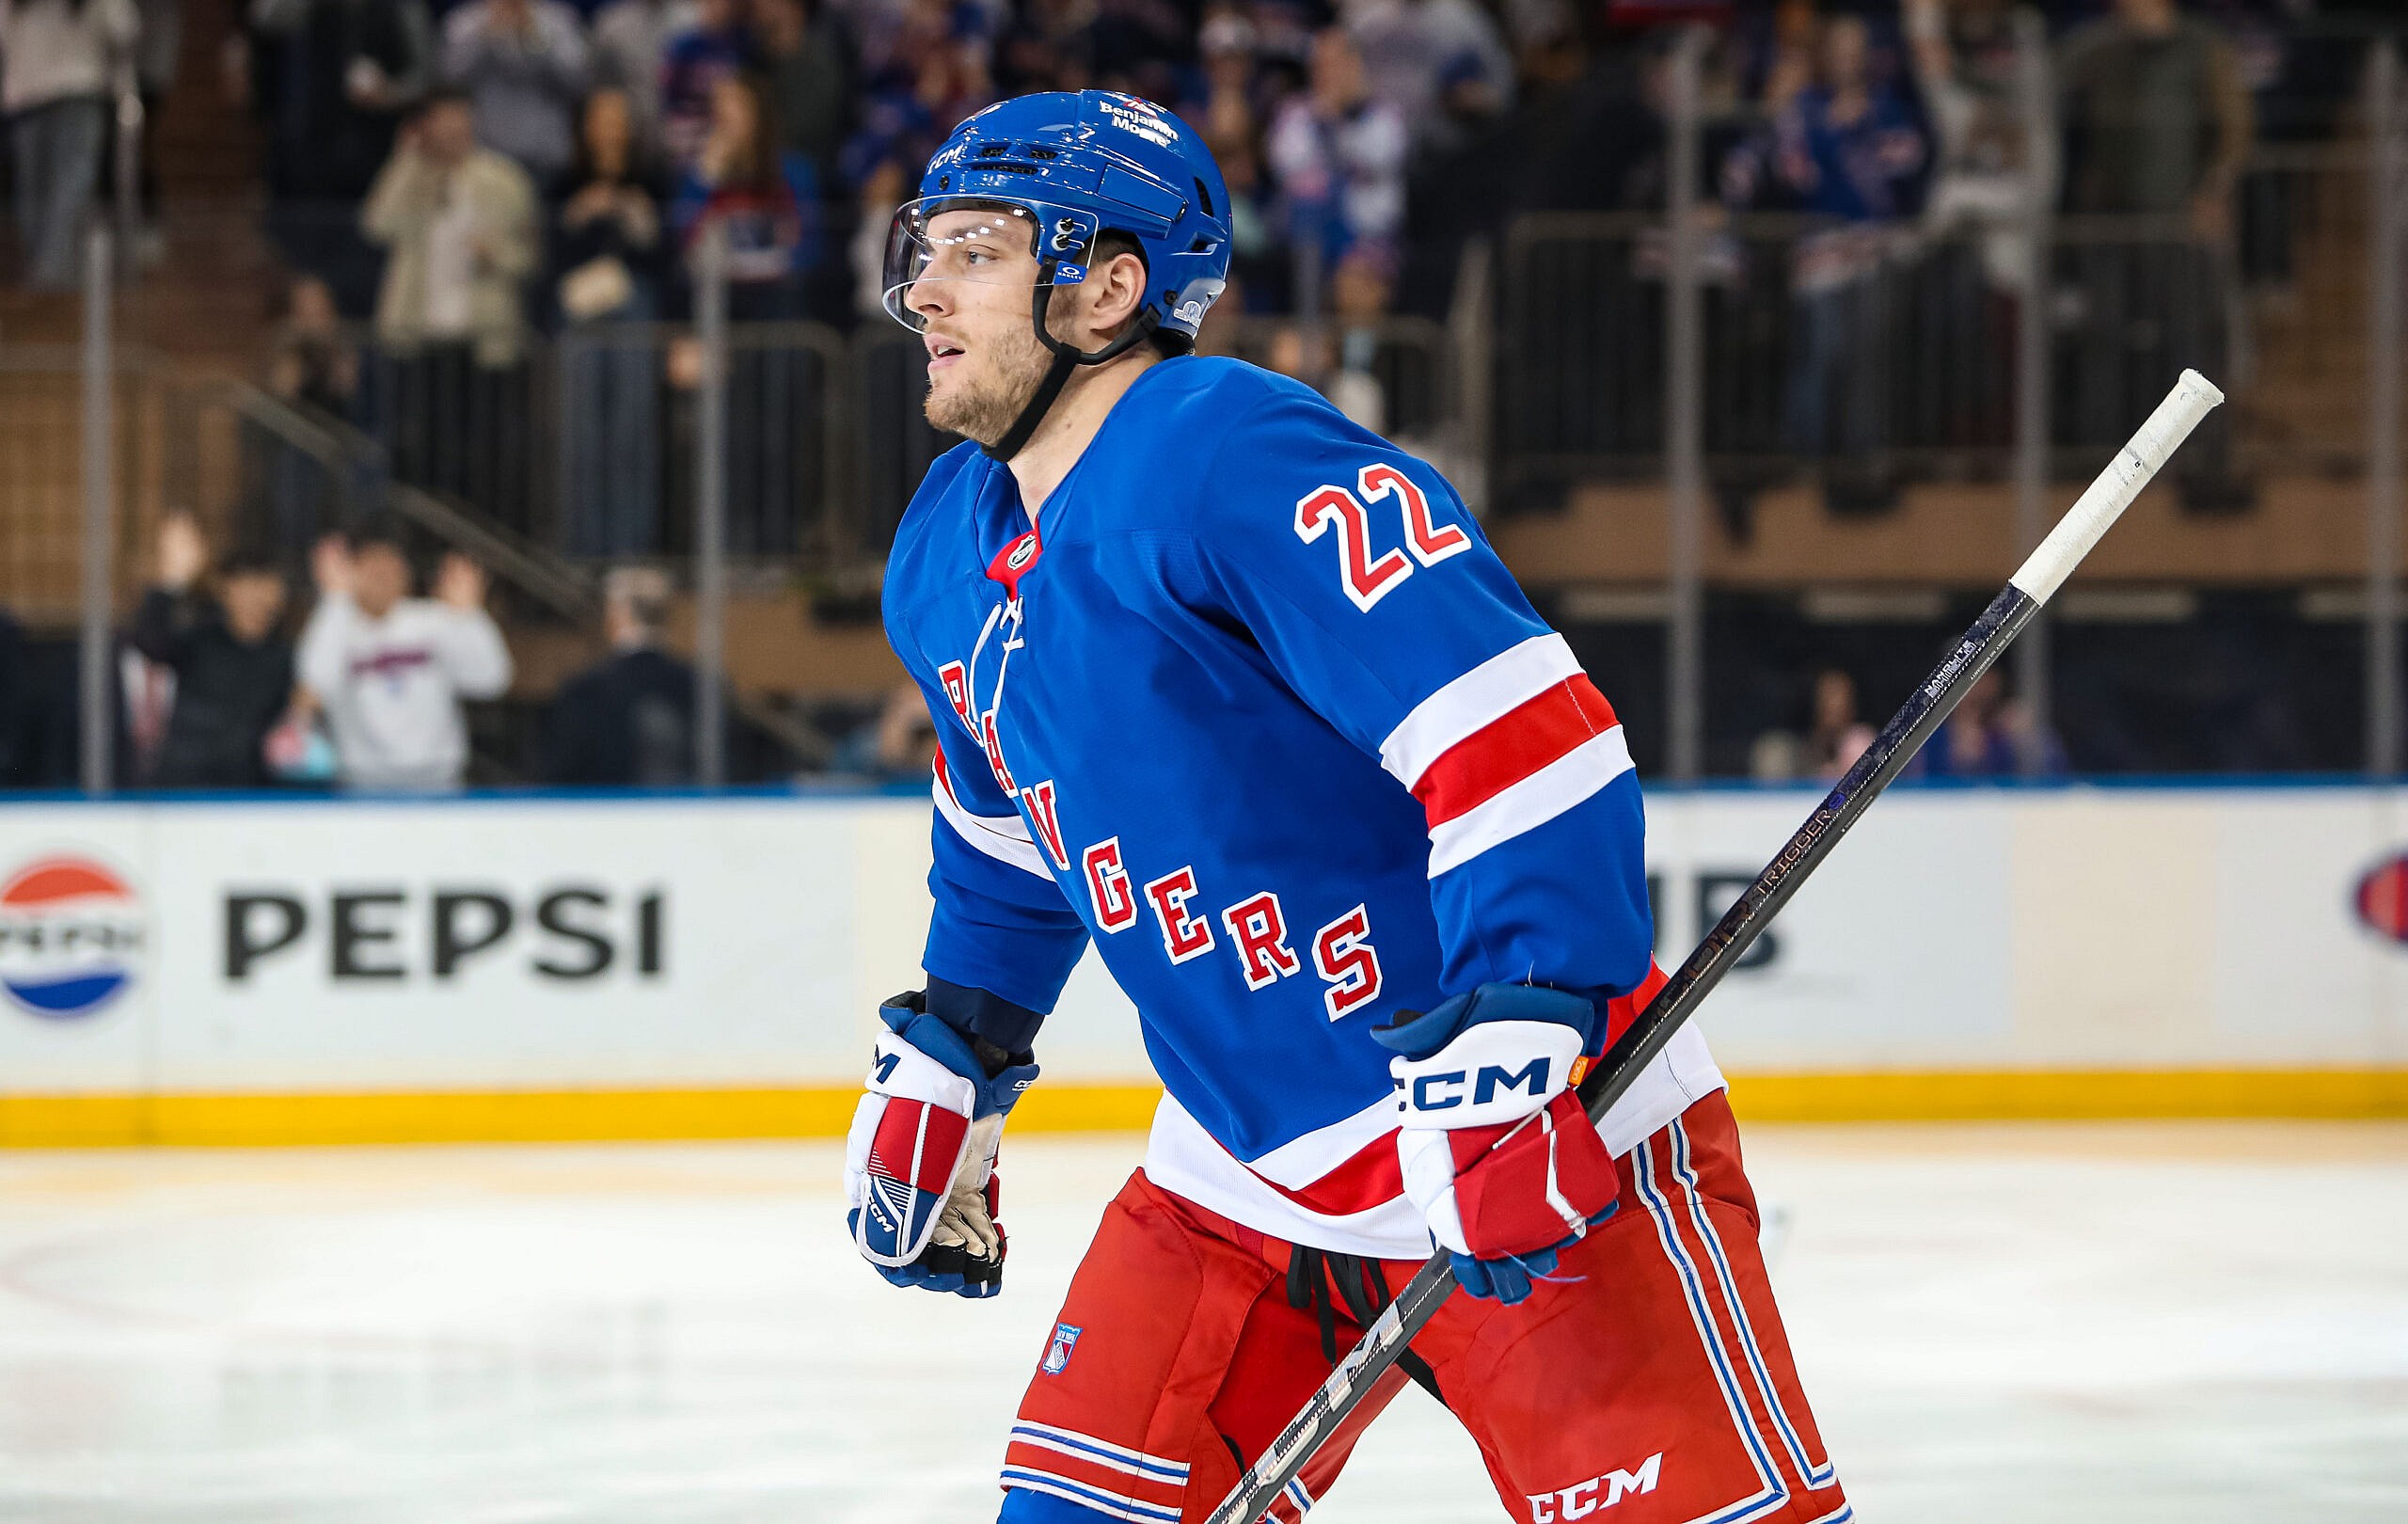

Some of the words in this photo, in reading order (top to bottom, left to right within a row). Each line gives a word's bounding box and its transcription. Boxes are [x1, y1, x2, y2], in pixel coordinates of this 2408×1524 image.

[1293, 462, 1472, 614] 22
[938, 659, 1384, 1024] RANGERS
[1752, 809, 1832, 895] TRIGGER
[223, 888, 664, 980] PEPSI
[1526, 1452, 1663, 1524] CCM
